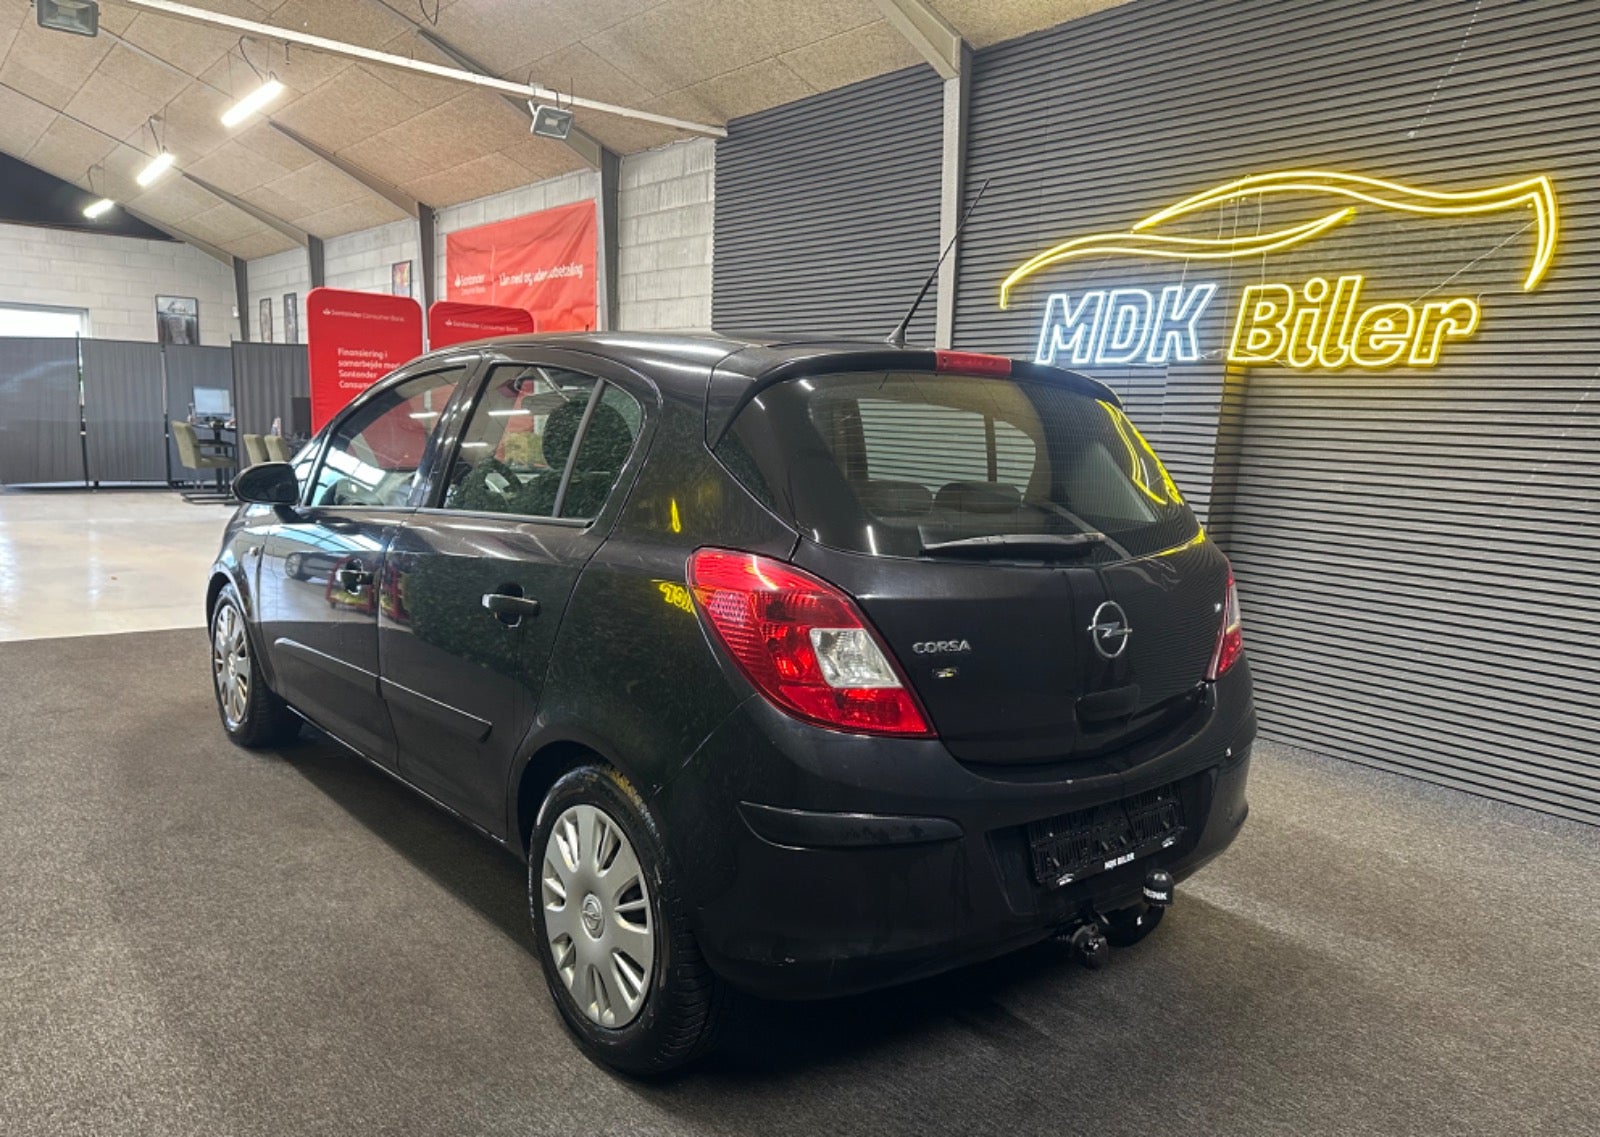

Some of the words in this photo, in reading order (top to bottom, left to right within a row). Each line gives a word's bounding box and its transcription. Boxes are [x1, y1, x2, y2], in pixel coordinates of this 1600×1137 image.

[1034, 283, 1217, 366] MDK
[1227, 274, 1481, 369] Biler
[337, 348, 384, 360] Finansiering
[338, 359, 382, 370] samarbejde
[338, 370, 378, 379] Santander
[912, 639, 971, 653] CORSA
